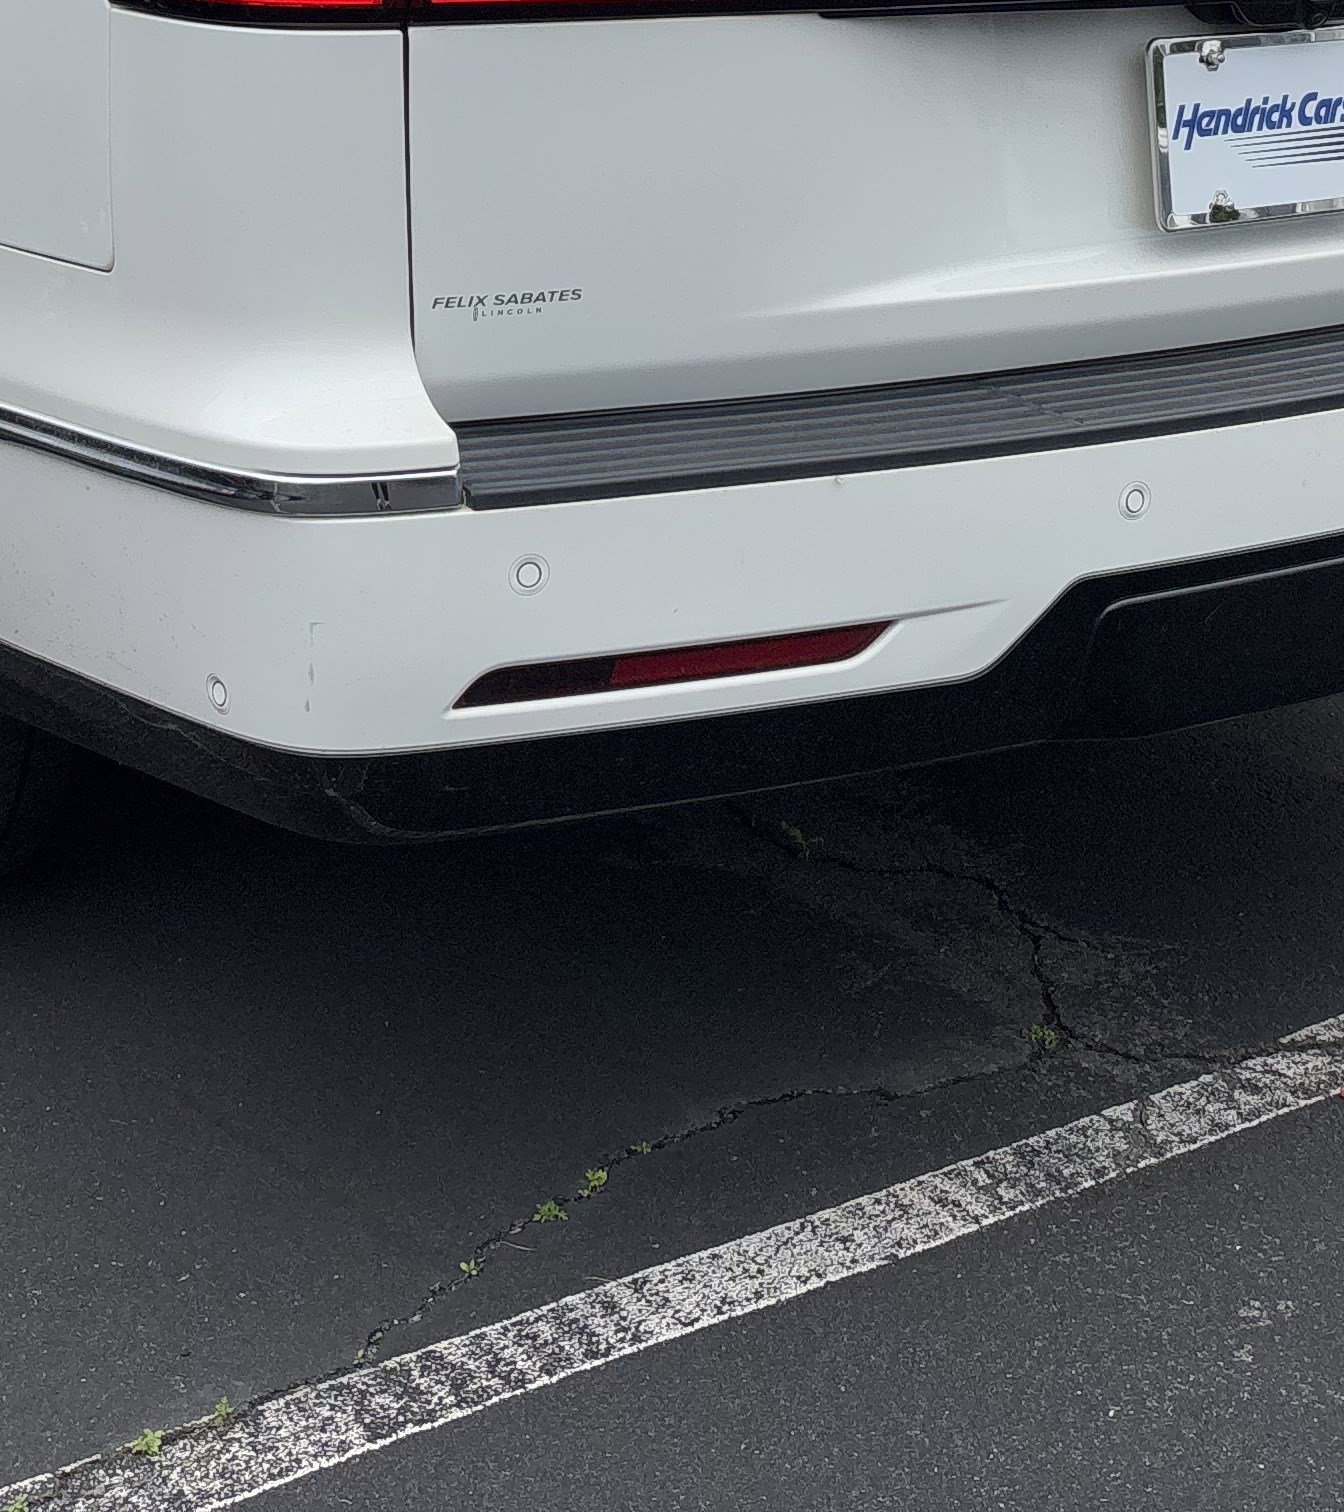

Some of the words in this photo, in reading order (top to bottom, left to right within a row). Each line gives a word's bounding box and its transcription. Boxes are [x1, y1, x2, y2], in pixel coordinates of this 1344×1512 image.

[1172, 94, 1296, 150] Hendrick
[432, 294, 489, 310] FELIX
[492, 288, 583, 306] SABATES
[481, 306, 543, 318] LINCOLN
